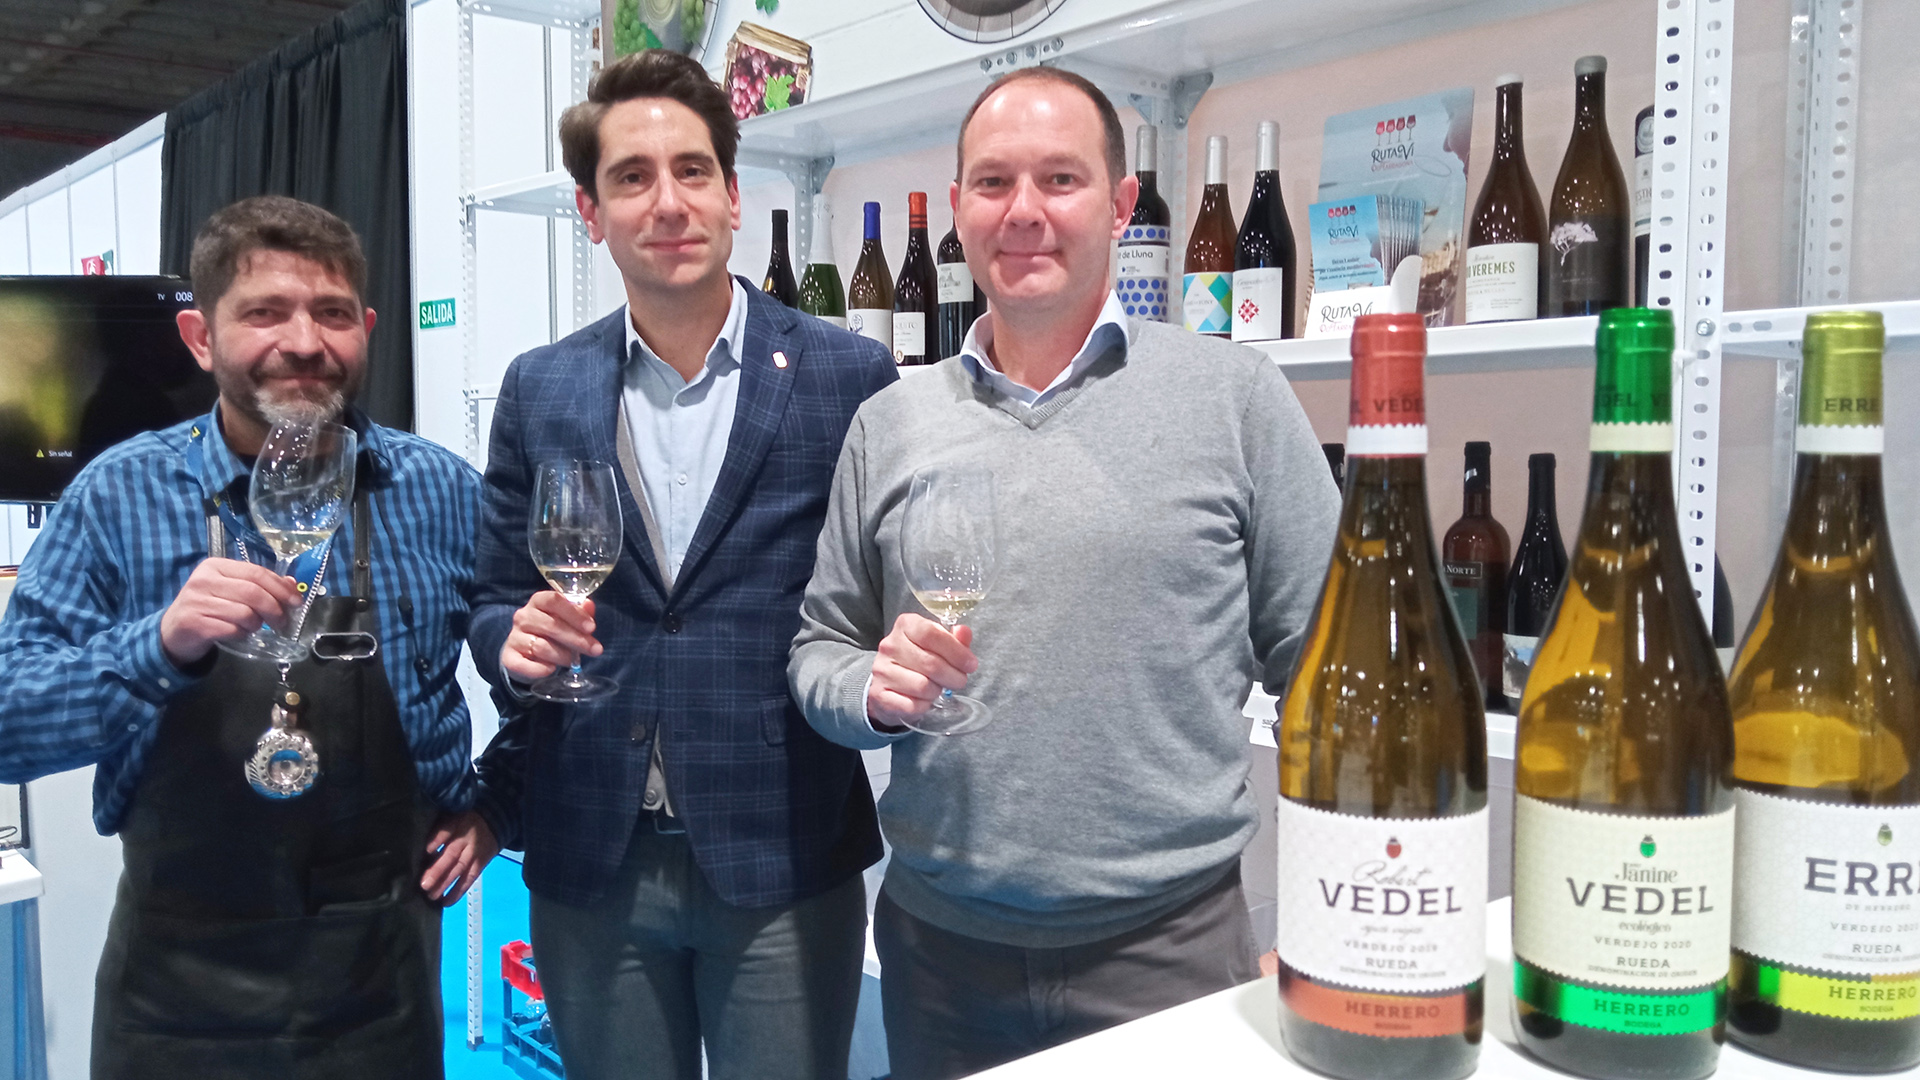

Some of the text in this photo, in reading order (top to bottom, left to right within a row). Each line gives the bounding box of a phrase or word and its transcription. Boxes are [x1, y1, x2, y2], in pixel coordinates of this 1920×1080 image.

[1122, 250, 1131, 259] de
[1131, 249, 1154, 259] Lluna
[1472, 261, 1516, 277] VEREMES
[157, 291, 194, 302] TV 008
[421, 302, 454, 325] SALIDA
[1321, 305, 1353, 324] RUTA
[49, 450, 58, 458] Sin
[1446, 564, 1477, 575] NORTE
[1352, 860, 1432, 886] Robert
[1615, 861, 1679, 883] Janine
[1804, 856, 1920, 897] ERR
[1319, 878, 1462, 916] VEDEL
[1566, 876, 1714, 916] VEDEL
[1830, 921, 1893, 933] VERDEJO
[1344, 939, 1405, 953] VERDEJO
[1594, 936, 1692, 950] VERDEJO 2020
[1852, 943, 1903, 955] RUEDA
[1365, 957, 1418, 970] RUEDA
[1616, 956, 1671, 969] RUEDA
[1828, 985, 1918, 1001] HERRERO
[1345, 1000, 1441, 1019] HERRERO
[1593, 998, 1690, 1017] HERRERO
